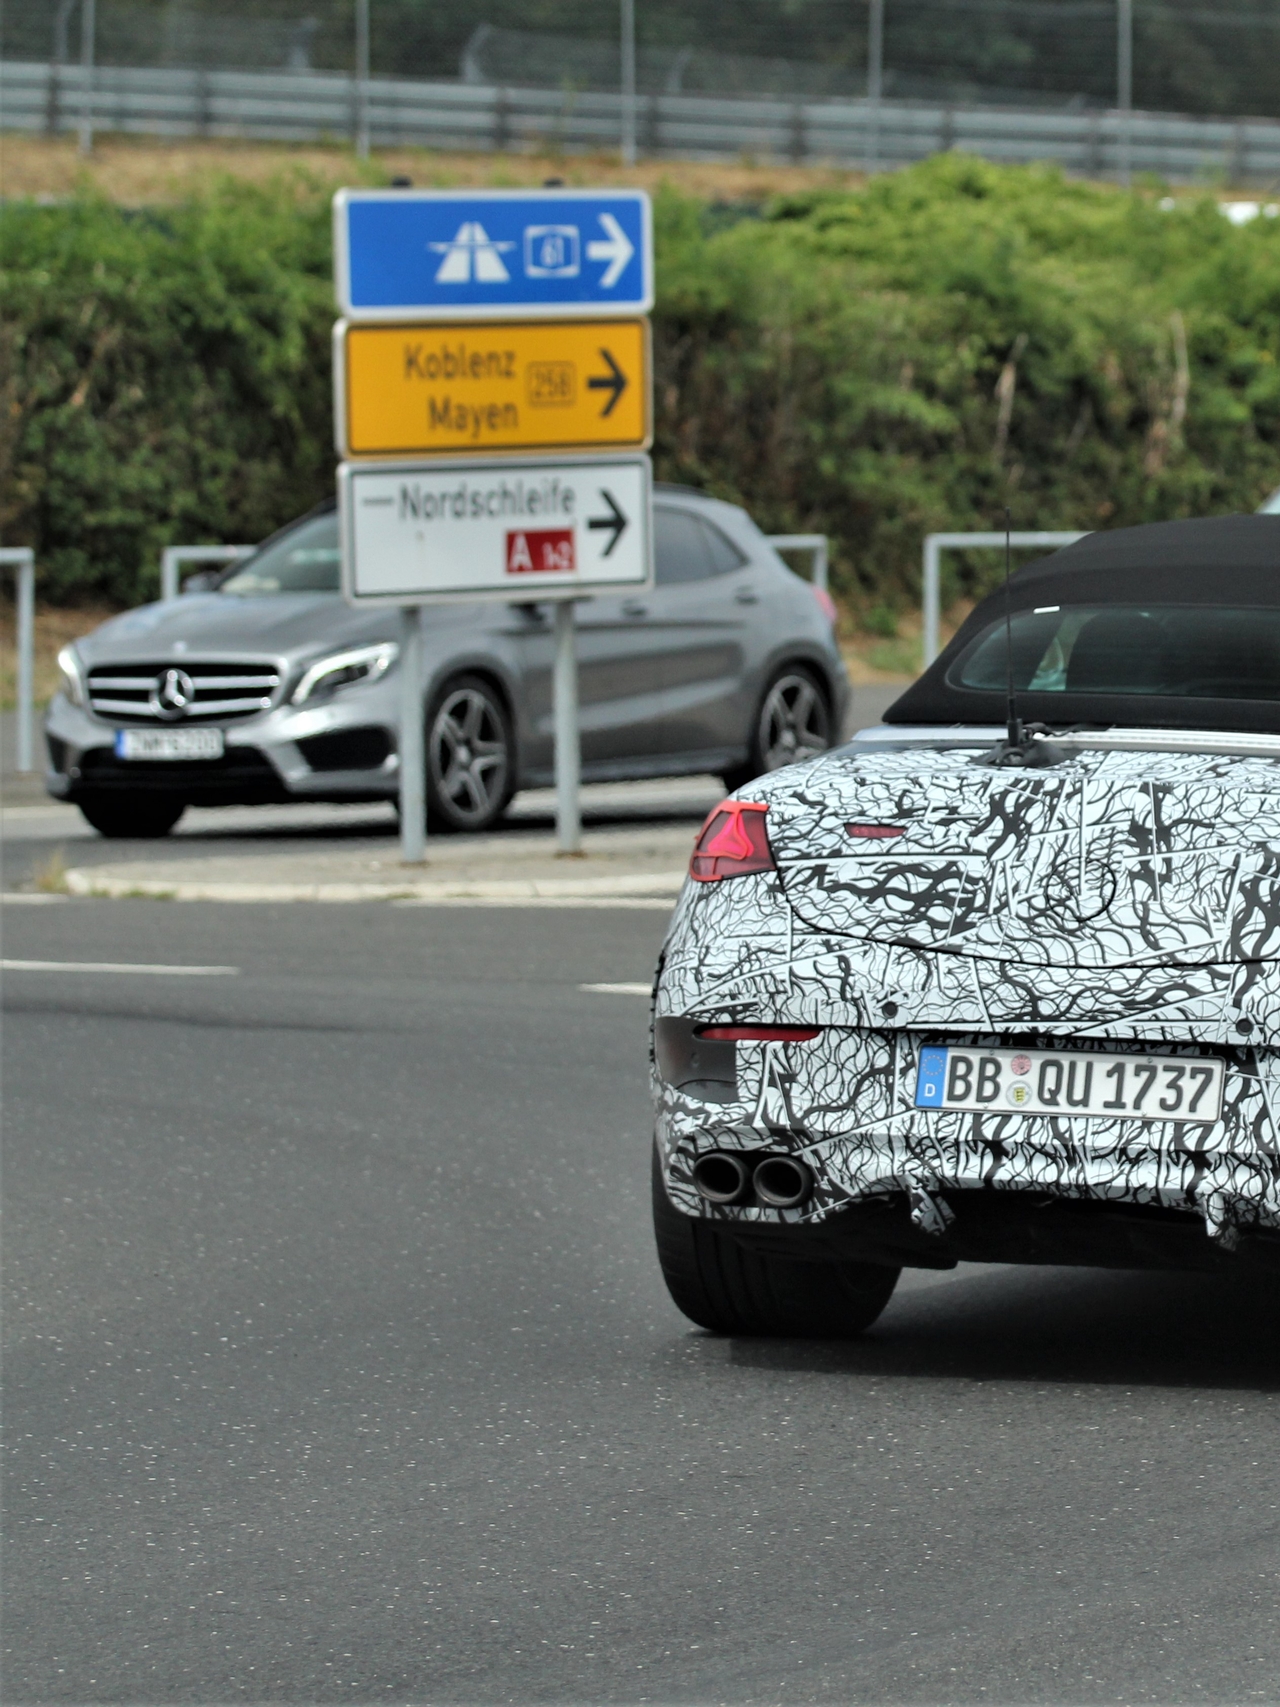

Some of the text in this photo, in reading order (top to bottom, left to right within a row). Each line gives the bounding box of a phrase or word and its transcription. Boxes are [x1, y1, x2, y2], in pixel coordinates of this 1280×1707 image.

[403, 343, 516, 380] Koblenz
[428, 397, 518, 440] Mayen
[398, 478, 575, 522] Nordschleife
[508, 531, 534, 570] A
[923, 1083, 936, 1097] D
[946, 1055, 1214, 1113] BB QU 1737
